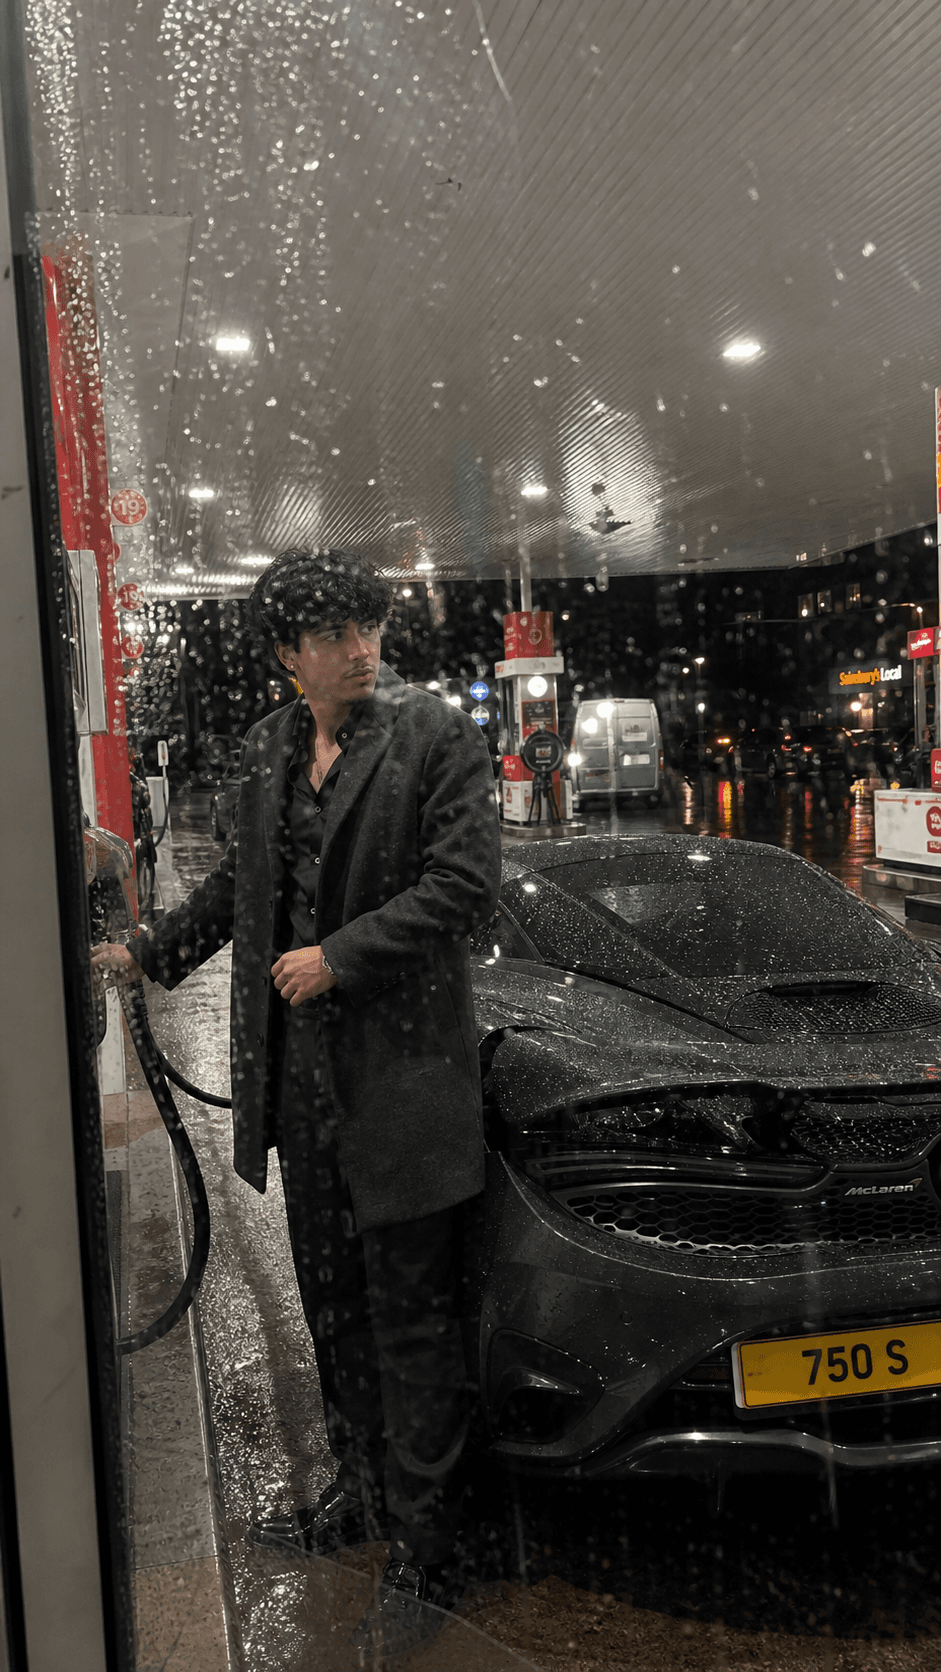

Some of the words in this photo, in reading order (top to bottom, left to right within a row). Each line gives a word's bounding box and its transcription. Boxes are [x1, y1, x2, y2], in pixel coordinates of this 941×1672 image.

[119, 499, 139, 515] 19
[880, 665, 902, 681] Local
[844, 1184, 914, 1196] McLaren
[802, 1343, 873, 1386] 750
[886, 1339, 909, 1376] S
